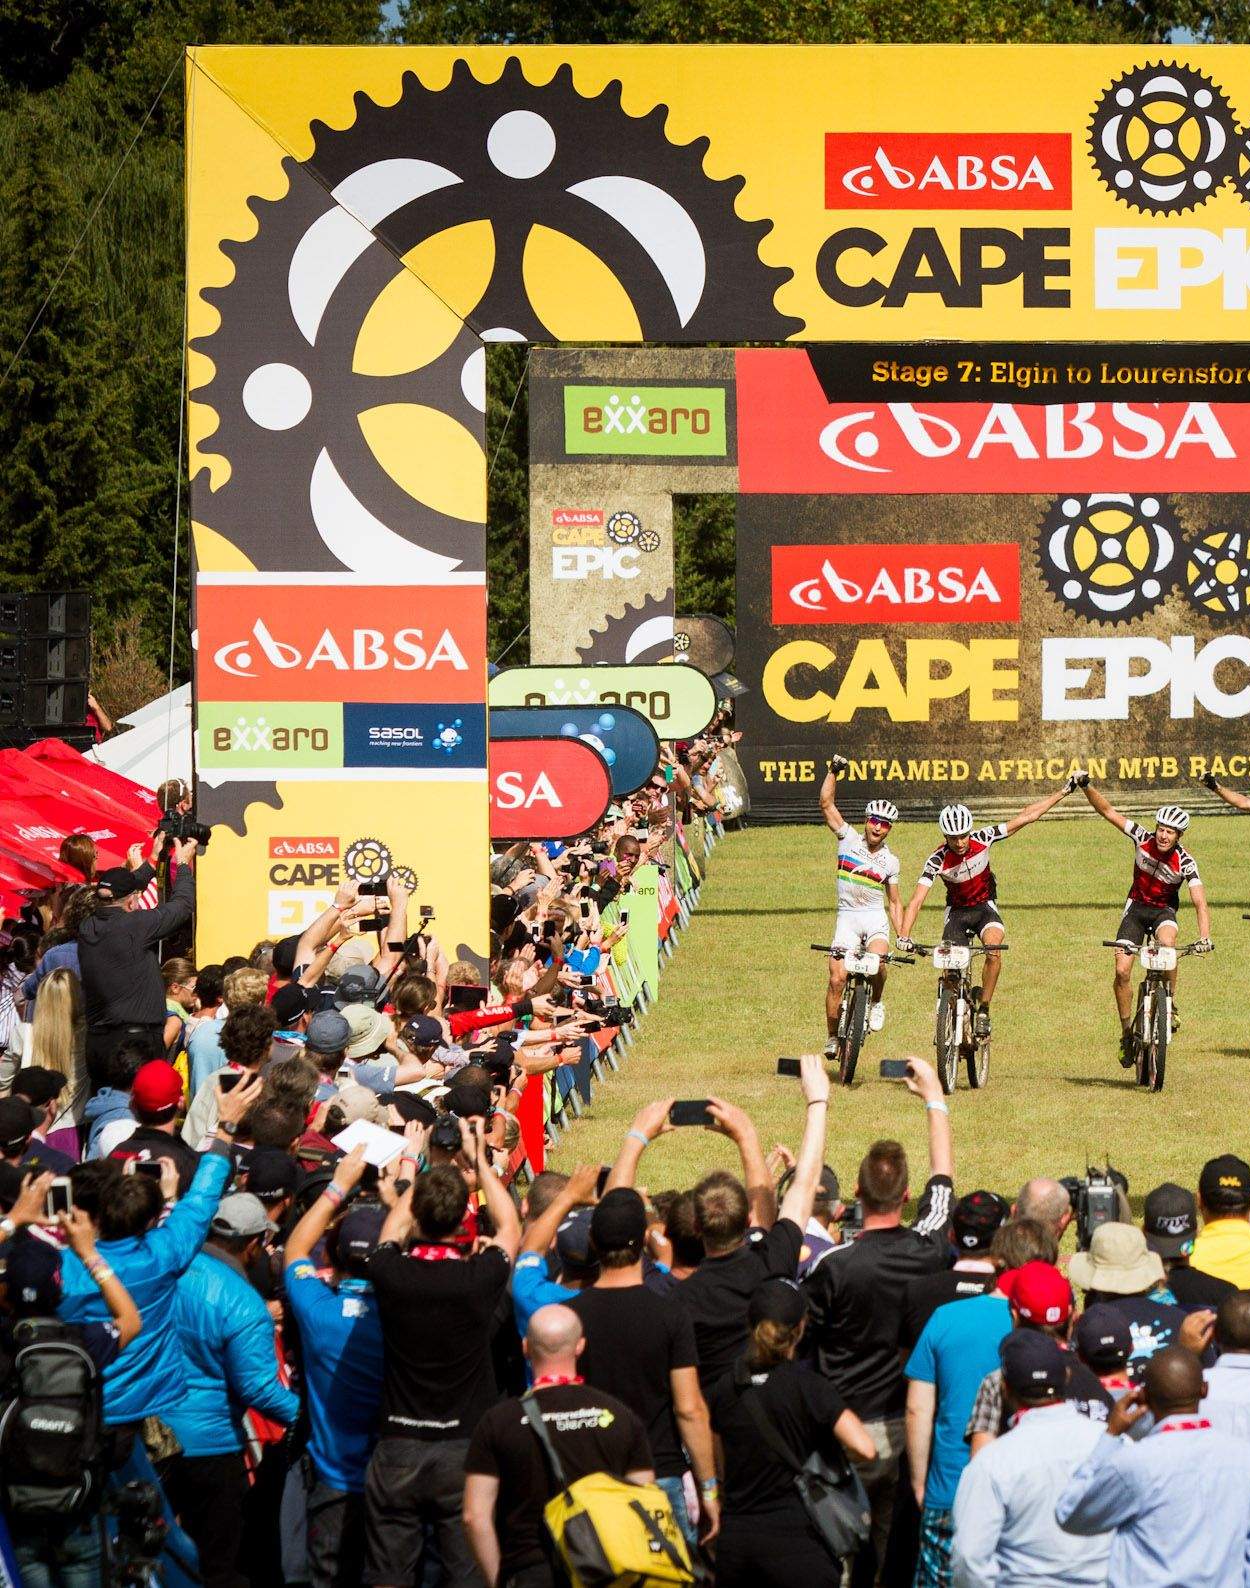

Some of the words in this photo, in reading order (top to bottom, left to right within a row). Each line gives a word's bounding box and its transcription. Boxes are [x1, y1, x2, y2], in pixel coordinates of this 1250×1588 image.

[917, 154, 1054, 191] ABSA
[815, 226, 1072, 309] CAPE
[871, 361, 949, 386] Stage
[957, 361, 983, 384] 7:
[989, 361, 1059, 386] Elgin
[1066, 363, 1092, 385] to
[582, 394, 711, 434] exxaro
[967, 402, 1238, 460] ABSA
[552, 528, 605, 545] CAPE
[573, 514, 600, 523] ABSA
[552, 546, 641, 579] EPIC
[865, 566, 1002, 604] ABSA
[305, 627, 470, 671] ABSA
[762, 637, 1020, 723] CAPE
[213, 717, 328, 752] exxaro
[759, 760, 816, 782] THE
[977, 757, 1108, 781] AFRICAN
[1118, 755, 1180, 779] MTB
[490, 771, 563, 809] SA
[295, 842, 335, 855] ABSA
[269, 863, 340, 886] CAPE
[268, 889, 335, 936] EP
